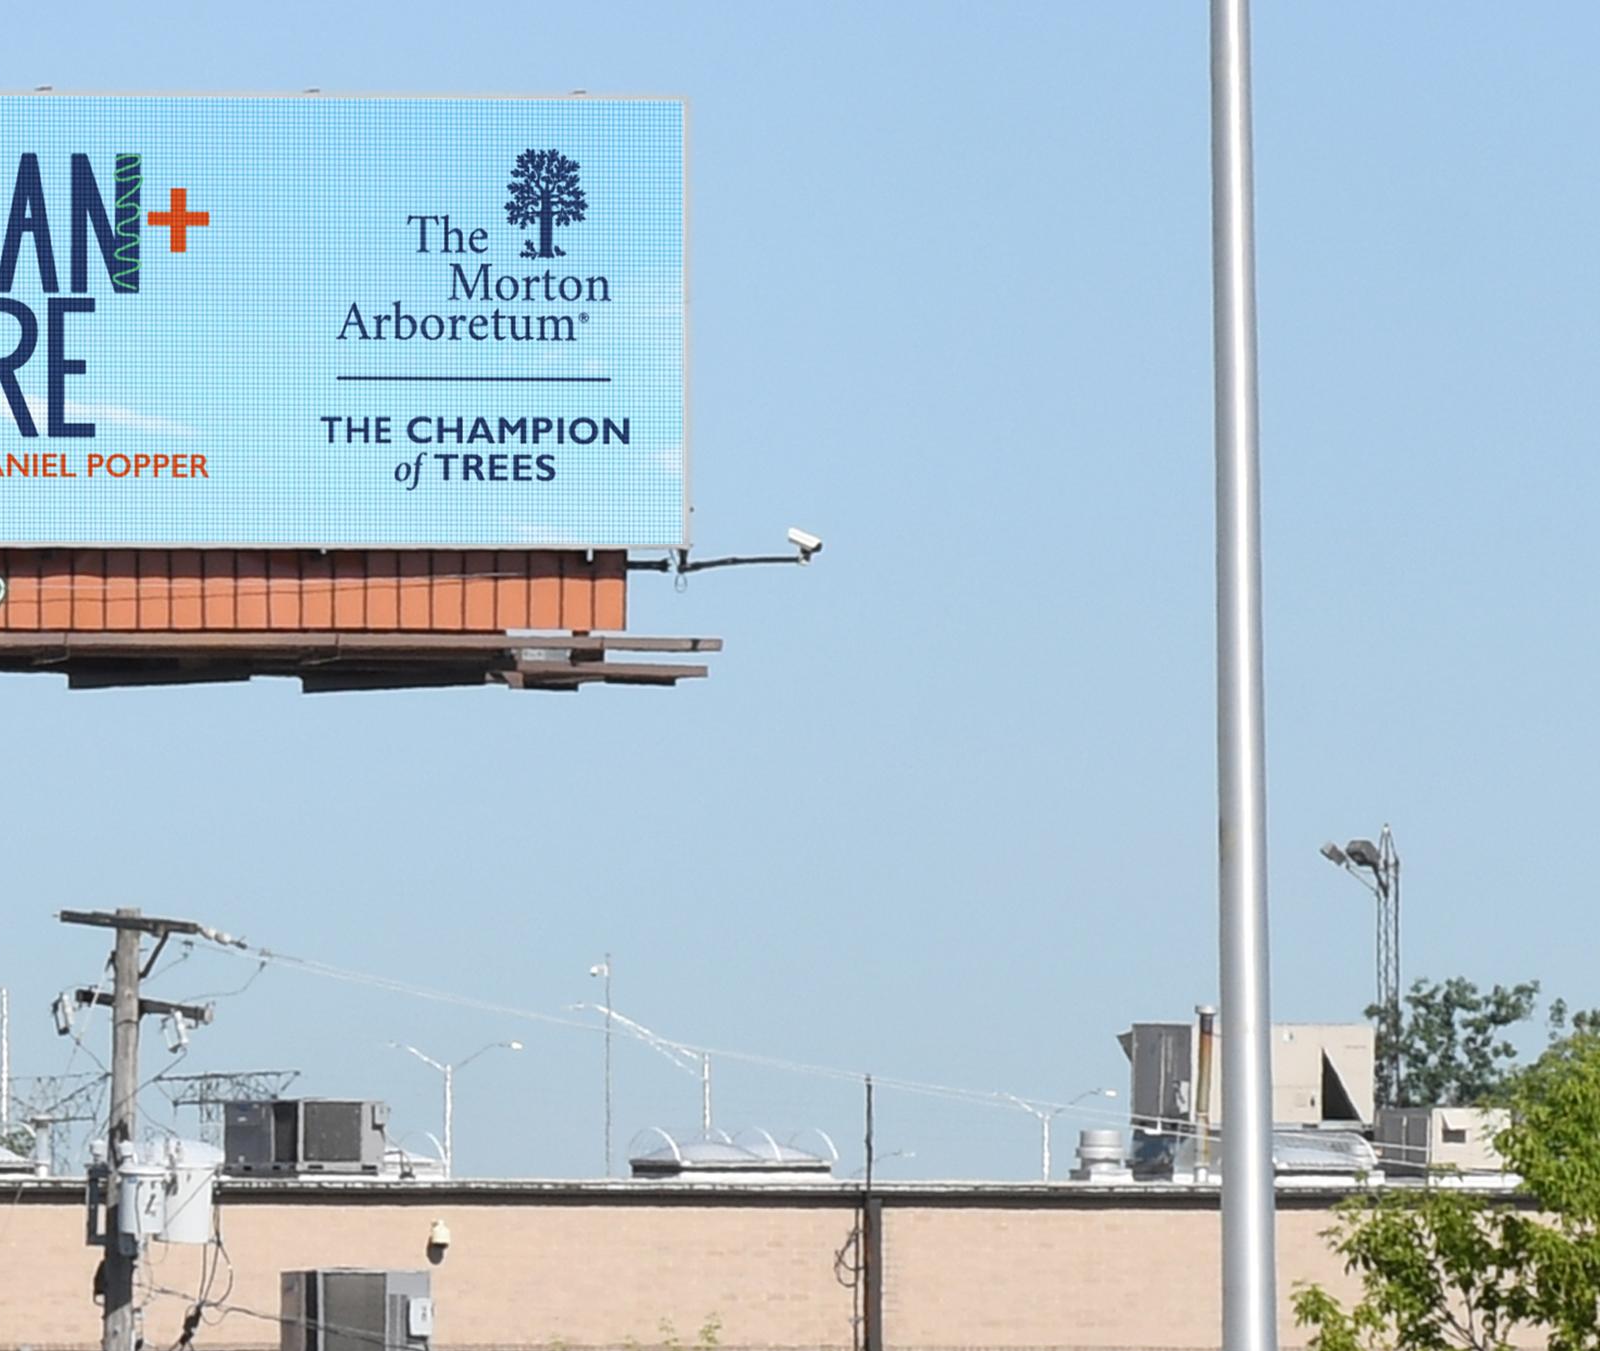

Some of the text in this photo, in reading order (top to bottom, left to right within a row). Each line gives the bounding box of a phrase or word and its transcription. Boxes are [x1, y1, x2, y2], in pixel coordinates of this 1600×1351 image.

[406, 214, 489, 253] The
[447, 263, 612, 302] Morton
[320, 416, 631, 445] THE CHAMPION
[87, 453, 209, 479] POPPER
[393, 452, 556, 491] of TREES
